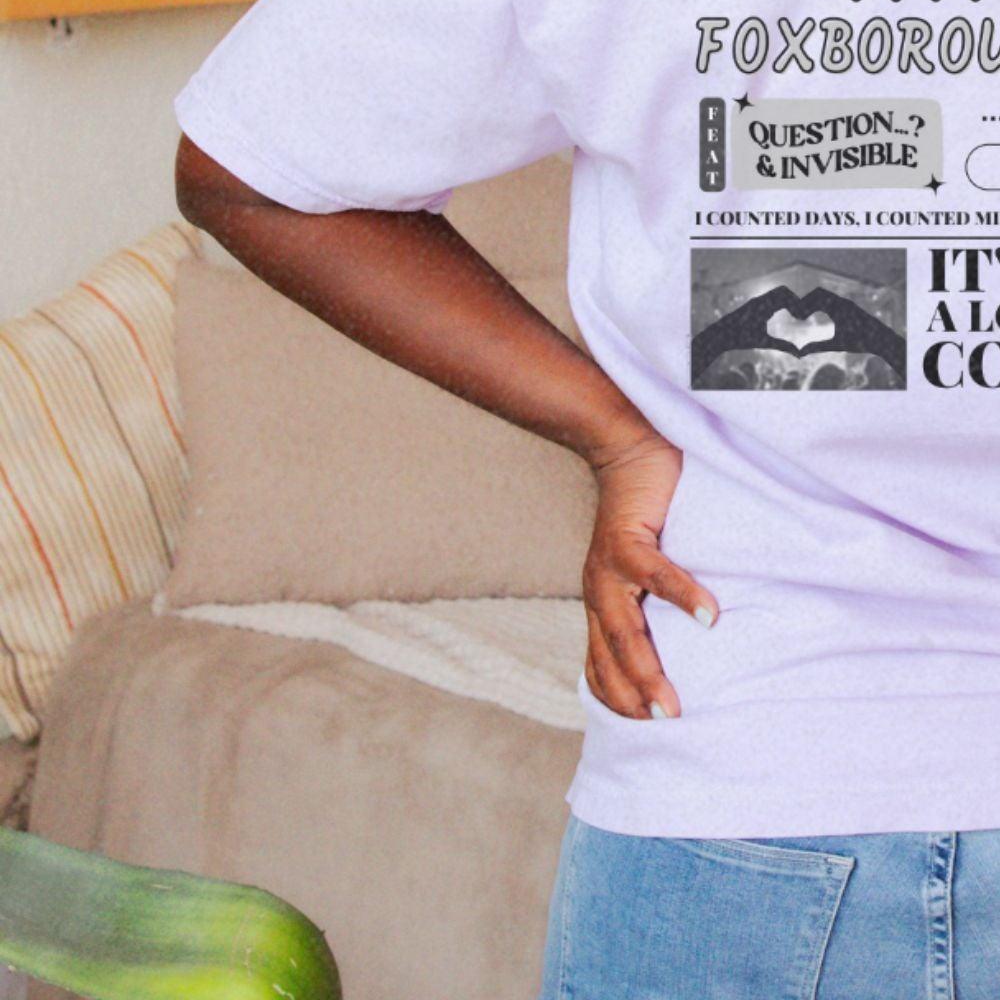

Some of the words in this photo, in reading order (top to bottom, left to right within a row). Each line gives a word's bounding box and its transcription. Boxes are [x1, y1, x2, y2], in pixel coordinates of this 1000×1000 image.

[705, 106, 720, 186] FEAT
[755, 153, 778, 178] &
[780, 141, 918, 180] INVISIBLE
[695, 211, 702, 226] I
[706, 211, 801, 226] COUNTED
[805, 211, 861, 228] DAYS,
[865, 211, 872, 226] I
[876, 211, 971, 226] COUNTED
[926, 300, 958, 333] A
